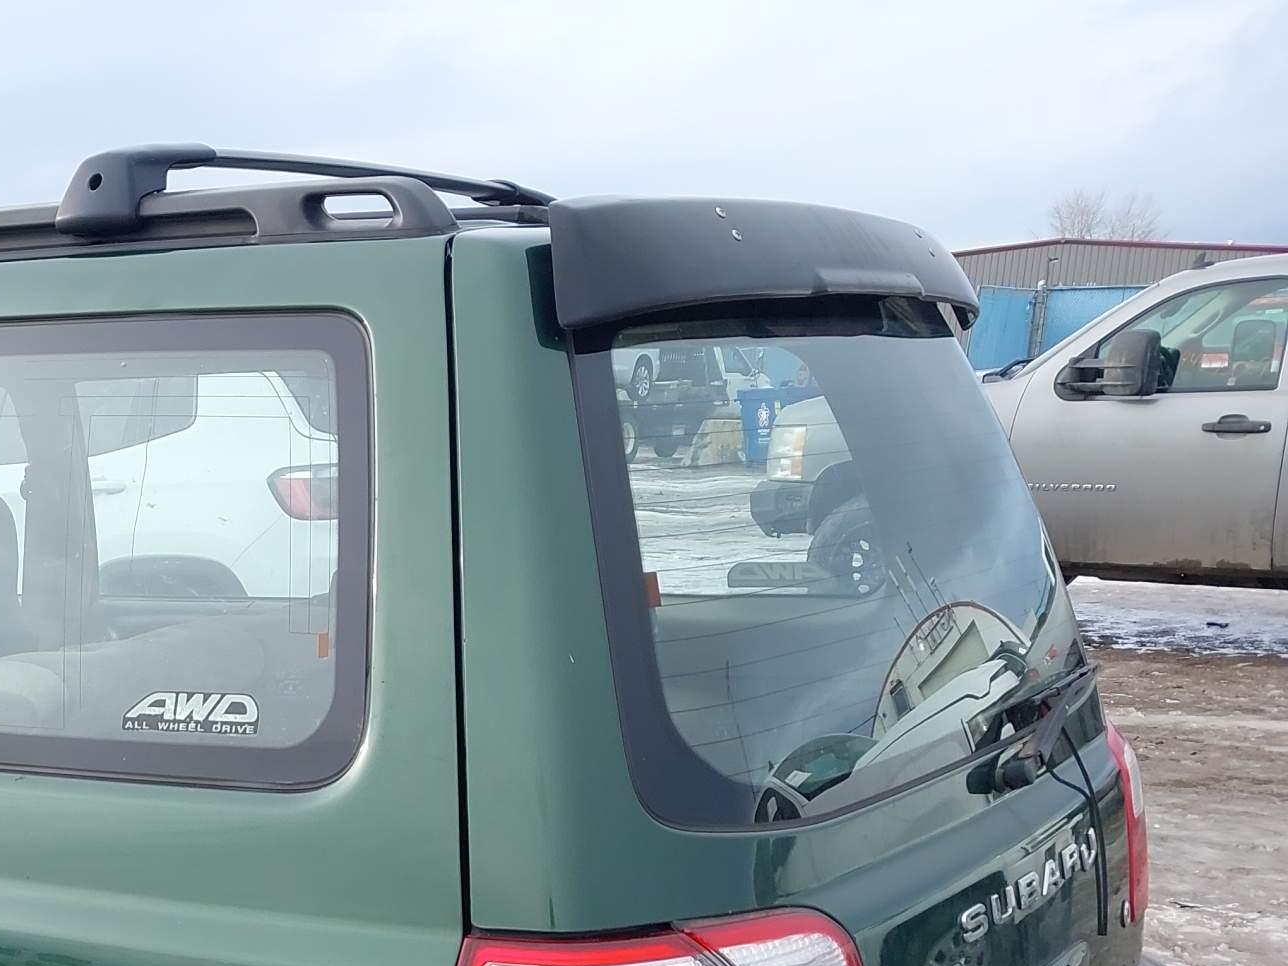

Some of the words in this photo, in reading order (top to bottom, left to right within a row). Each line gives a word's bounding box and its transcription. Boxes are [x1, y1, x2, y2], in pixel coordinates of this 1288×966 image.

[125, 692, 259, 723] AWD
[124, 720, 150, 730] ALL
[158, 721, 205, 732] WHEEL
[212, 723, 256, 734] DRIVE
[961, 826, 1098, 944] SUBARU
